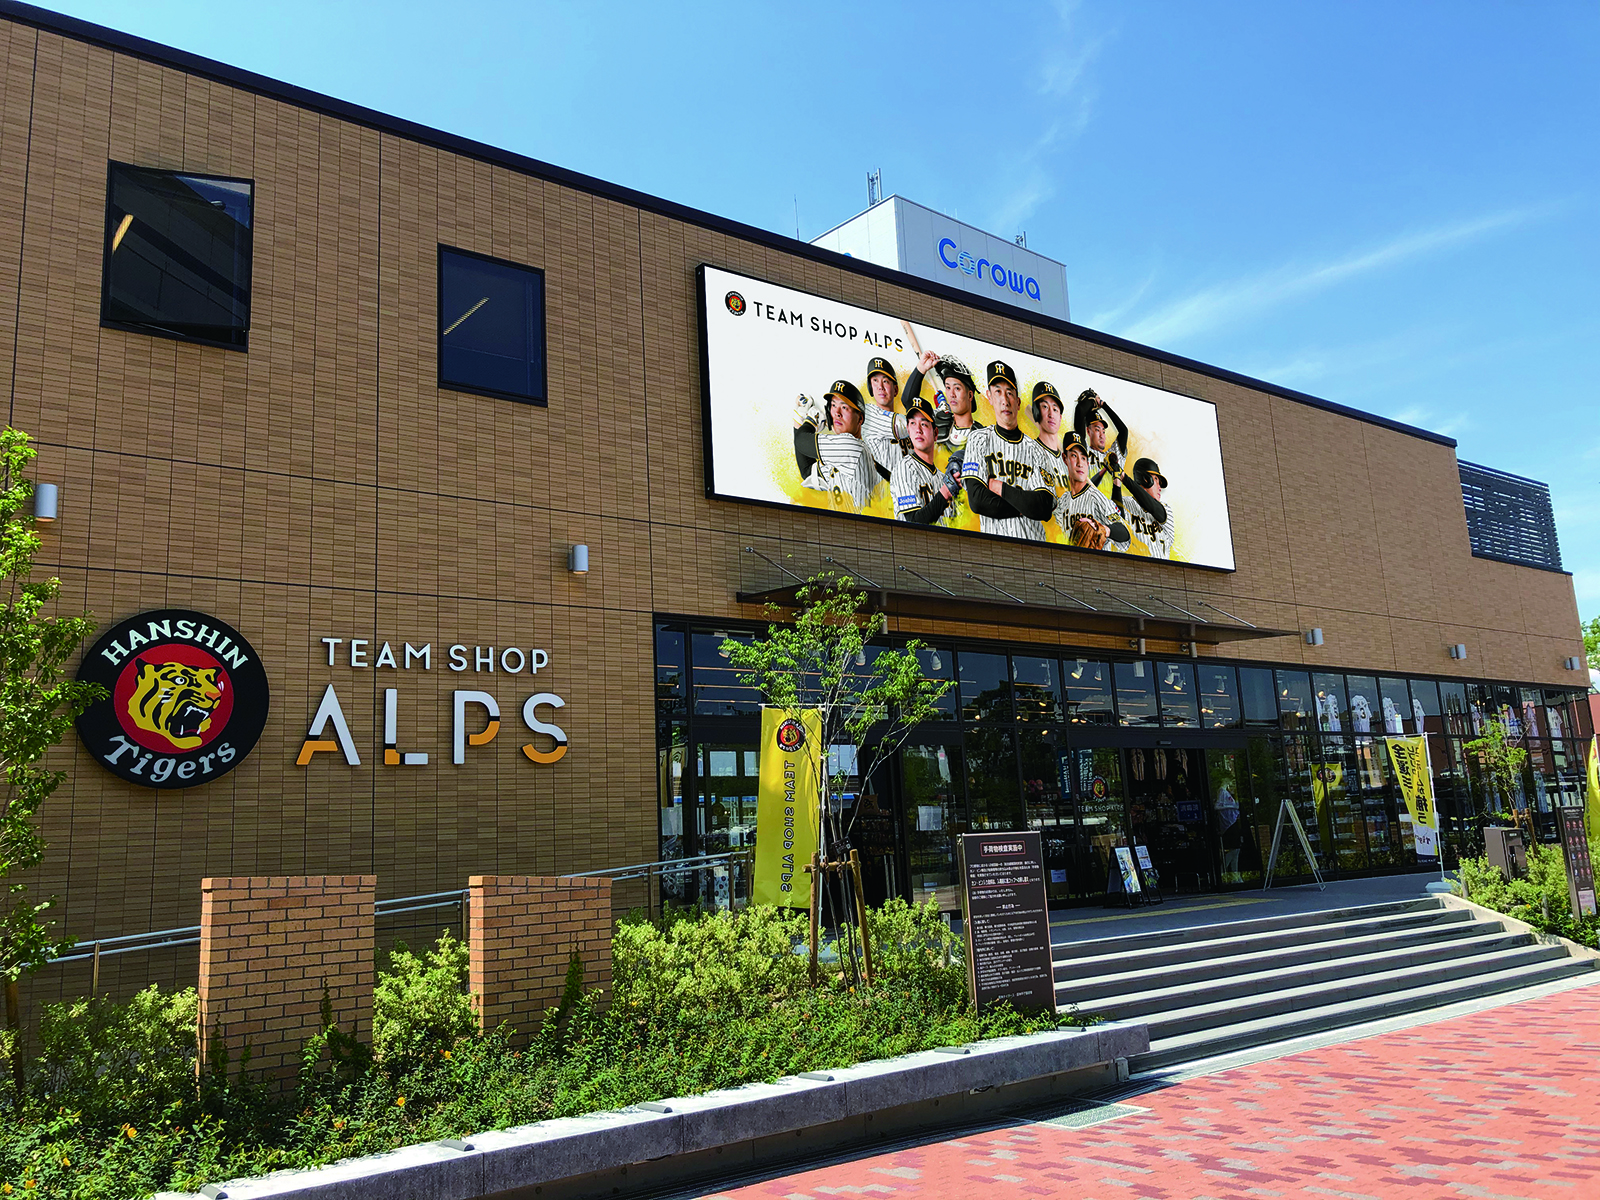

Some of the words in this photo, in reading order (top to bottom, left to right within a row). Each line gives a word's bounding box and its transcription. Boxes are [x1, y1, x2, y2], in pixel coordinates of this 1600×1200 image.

[938, 238, 1040, 301] Corowa
[753, 300, 803, 328] TEAM
[810, 316, 858, 341] SHOP
[863, 330, 904, 353] ALPS
[985, 461, 1034, 496] Tiger
[101, 619, 248, 670] HANSHIN
[321, 637, 431, 670] TEAM
[448, 644, 549, 674] SHOP
[295, 683, 568, 766] ALPS
[103, 735, 236, 783] Tigers
